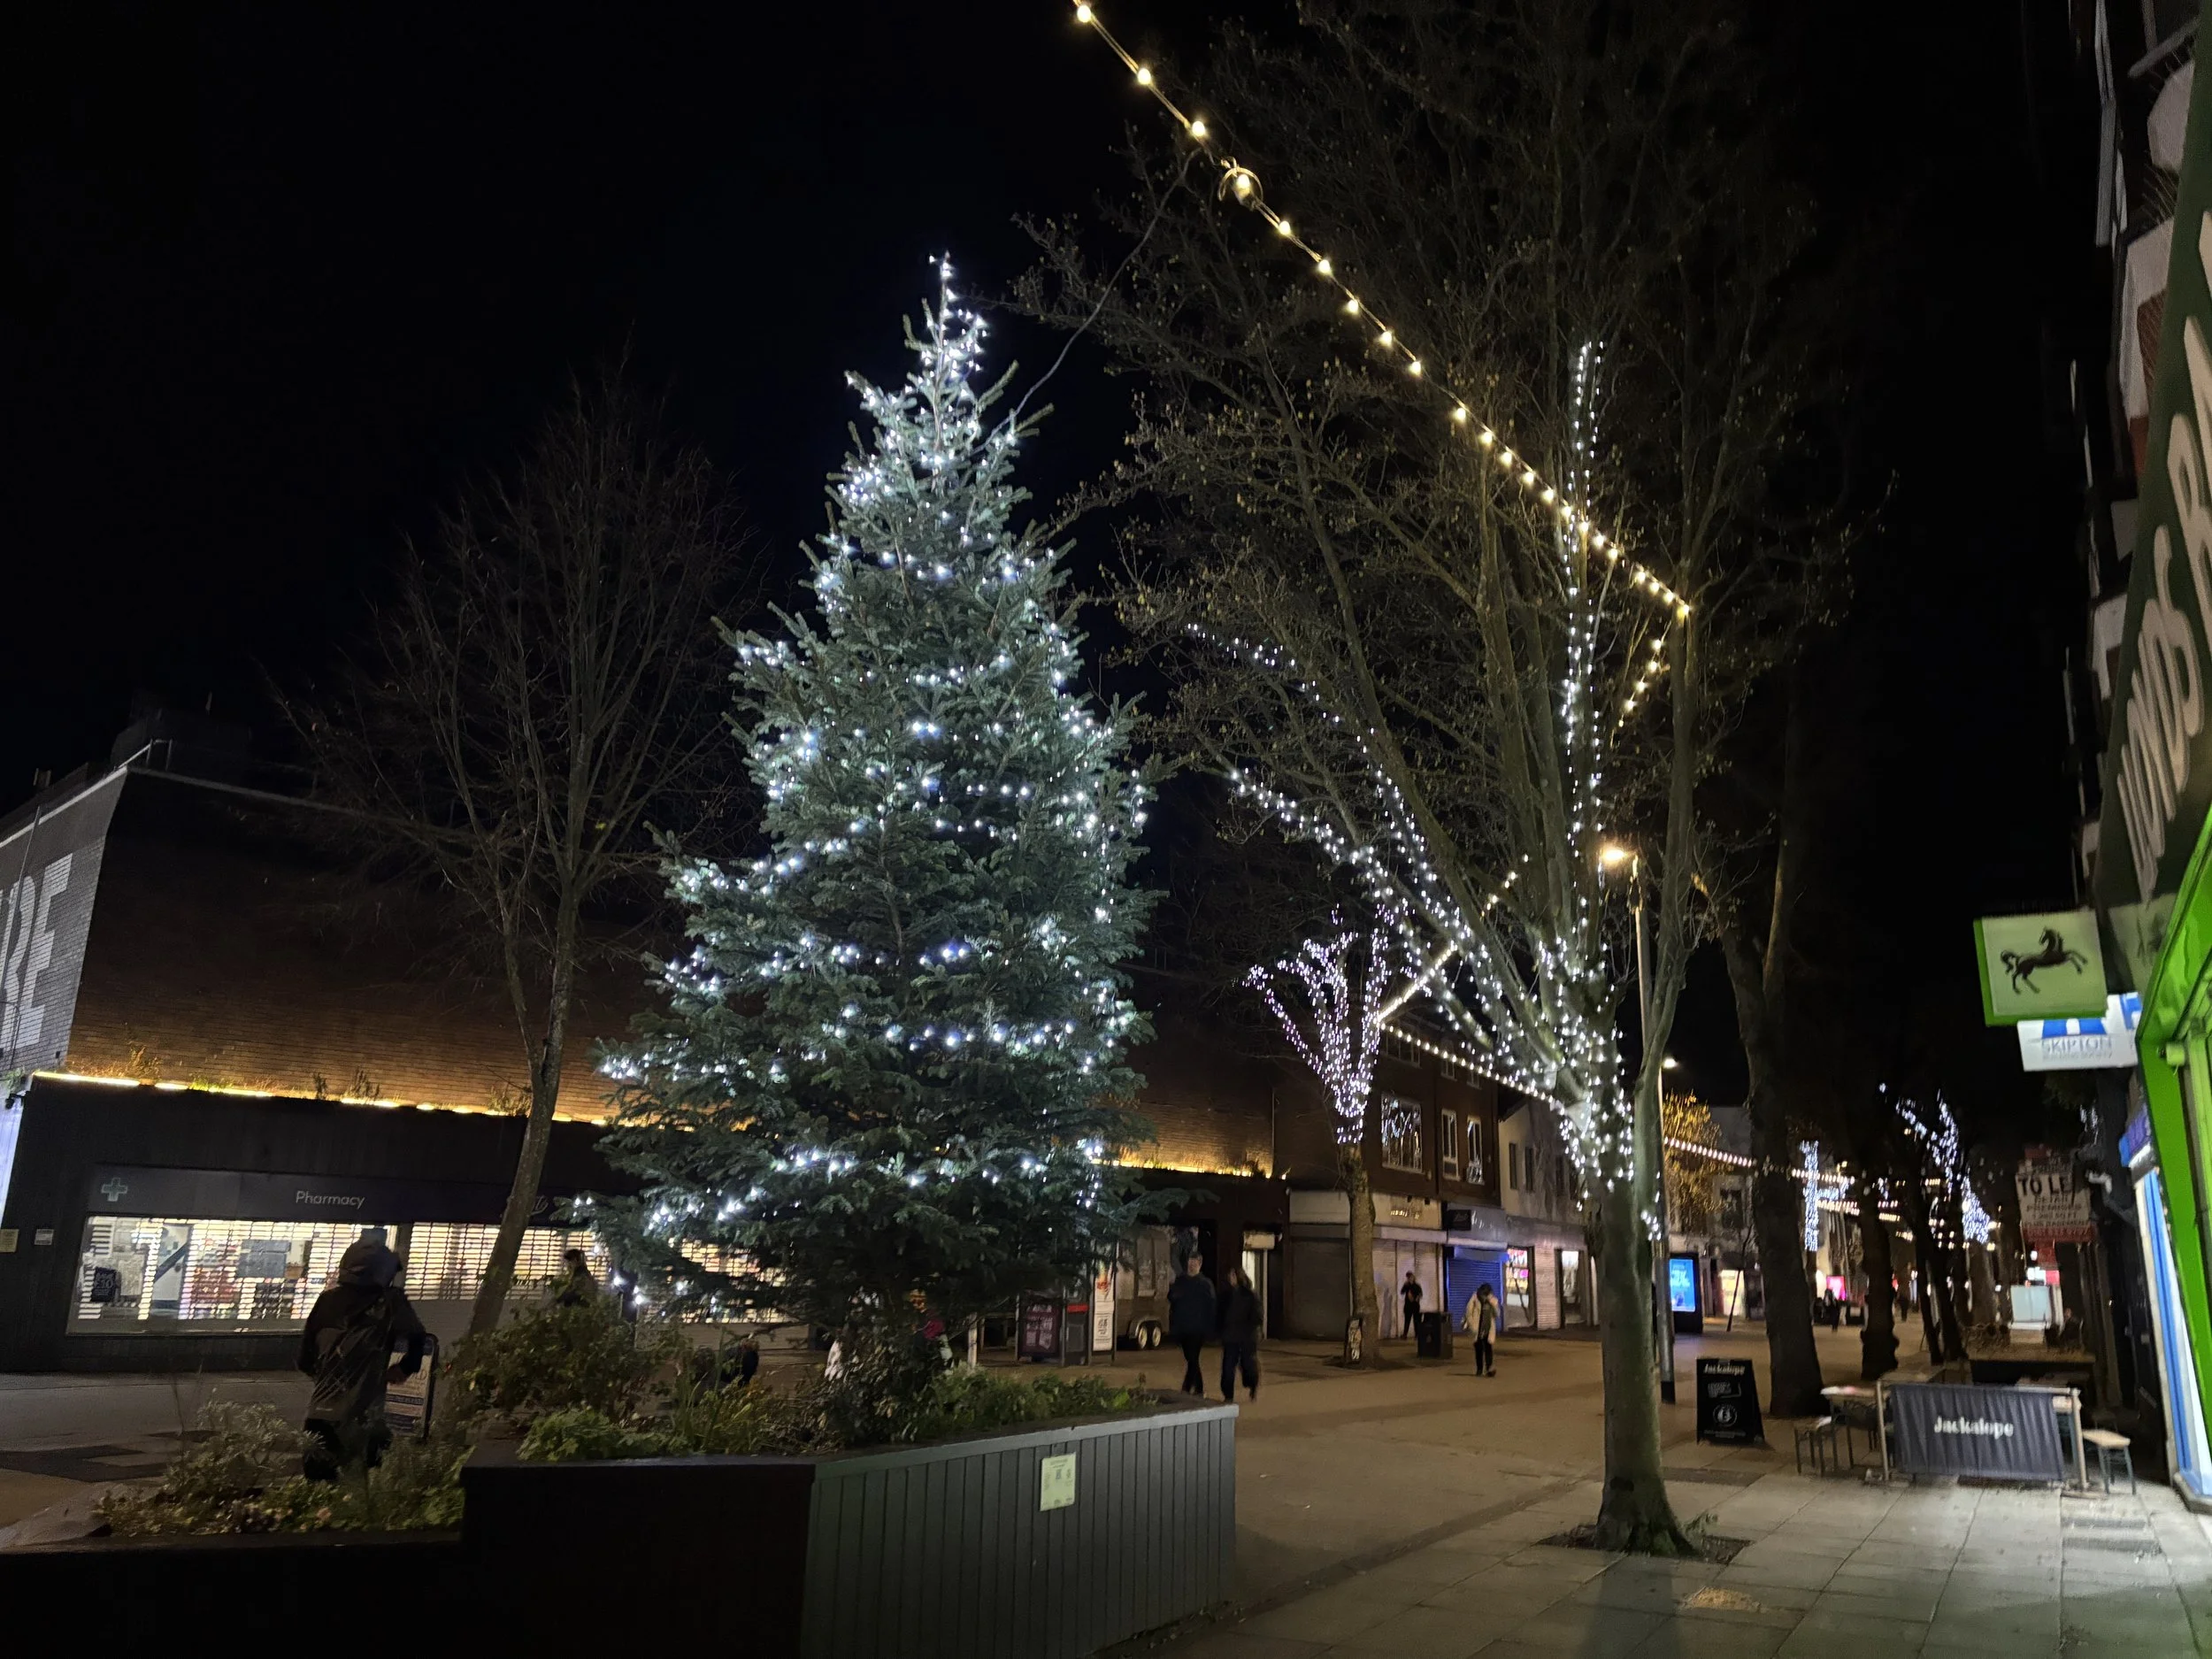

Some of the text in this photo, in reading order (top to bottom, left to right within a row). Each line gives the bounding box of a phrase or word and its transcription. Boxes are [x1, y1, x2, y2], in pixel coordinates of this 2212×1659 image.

[2041, 1036, 2112, 1053] SKIPTON
[2017, 1174, 2042, 1196] TO
[296, 1190, 365, 1210] Pharmacy
[1934, 1416, 2014, 1440] Jackalope
